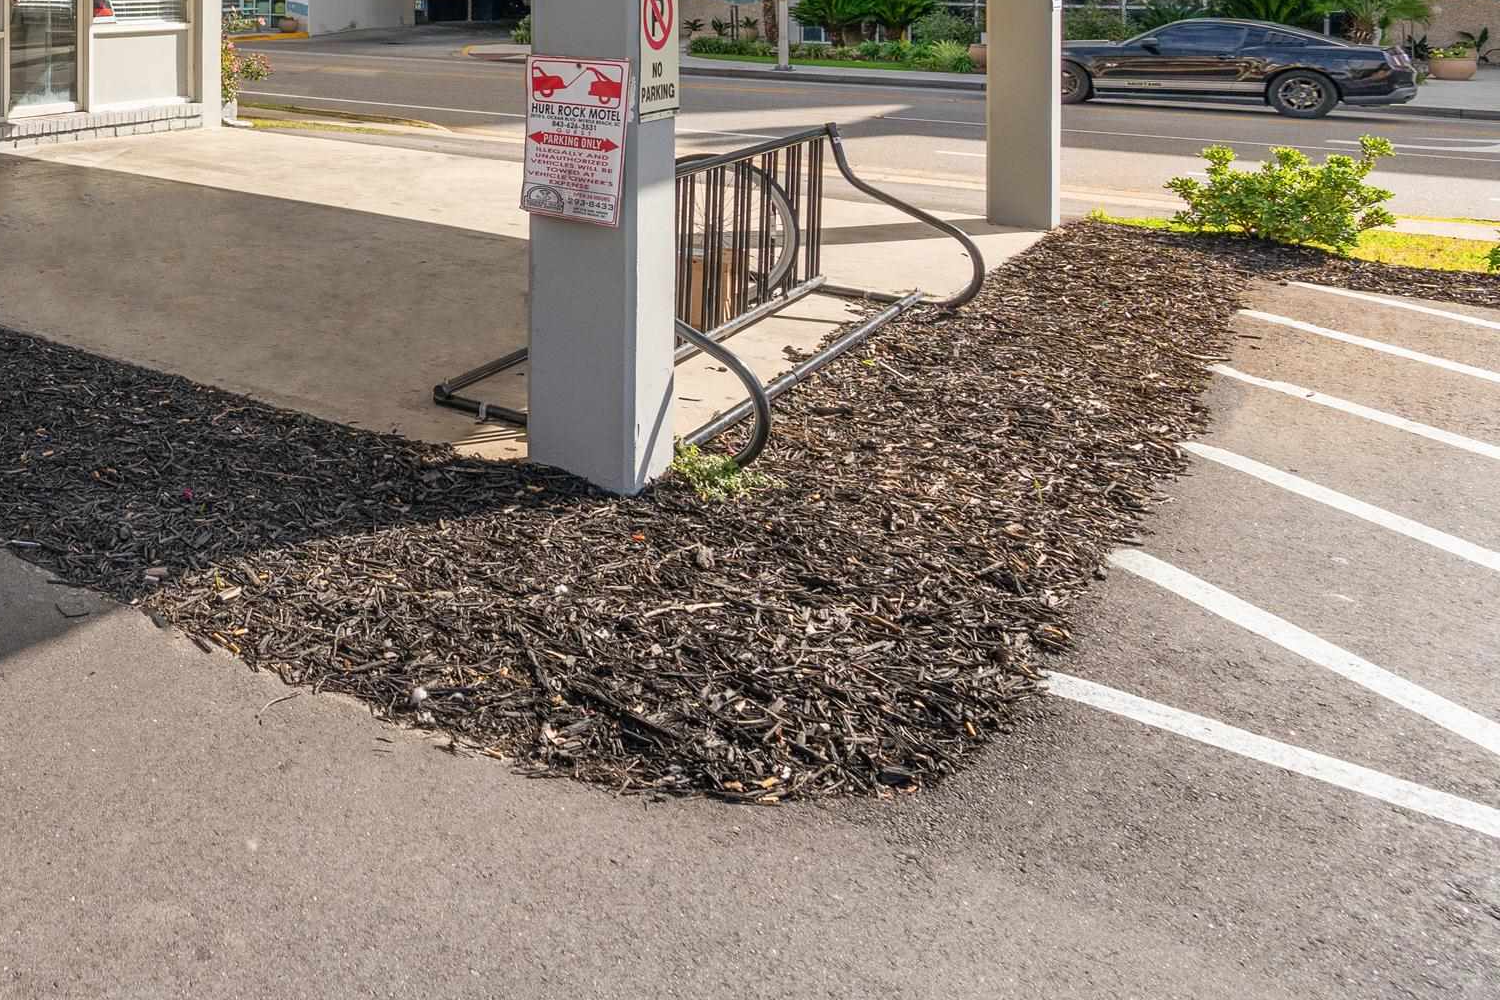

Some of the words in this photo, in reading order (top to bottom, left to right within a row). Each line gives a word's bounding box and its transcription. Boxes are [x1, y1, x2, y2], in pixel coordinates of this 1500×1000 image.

[652, 62, 663, 78] NO
[641, 83, 675, 103] PARKING
[531, 103, 554, 115] HURL
[558, 105, 587, 118] ROCK
[588, 108, 621, 121] MOTEL
[543, 134, 579, 147] PARKING
[581, 137, 602, 149] ONLY
[536, 147, 584, 156] ILLEGALLY
[531, 159, 574, 169] VEHICLES
[535, 153, 609, 167] UNAUTHORIZED
[528, 170, 568, 179] VEHICLE
[546, 166, 580, 175] TOWED
[548, 180, 590, 189] EXPENSE
